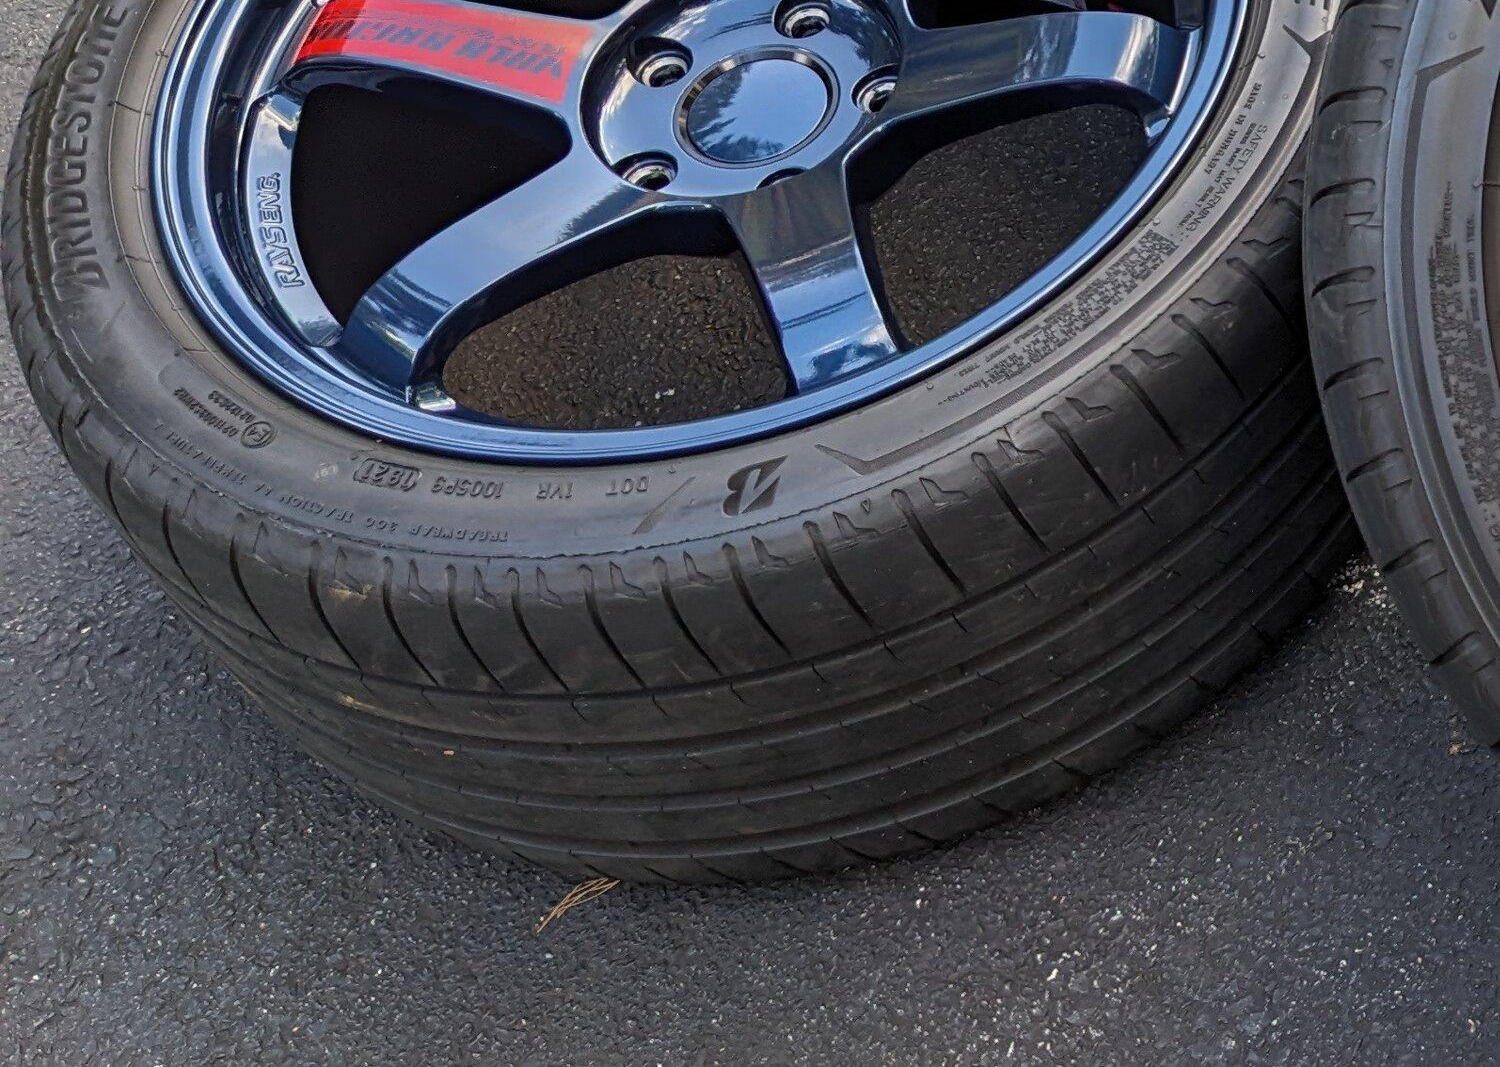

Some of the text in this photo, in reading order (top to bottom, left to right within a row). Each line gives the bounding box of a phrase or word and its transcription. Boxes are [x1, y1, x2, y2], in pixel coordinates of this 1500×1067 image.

[49, 4, 129, 301] BRIDGESTONE
[258, 226, 306, 289] RAYS
[605, 475, 652, 496] DOT
